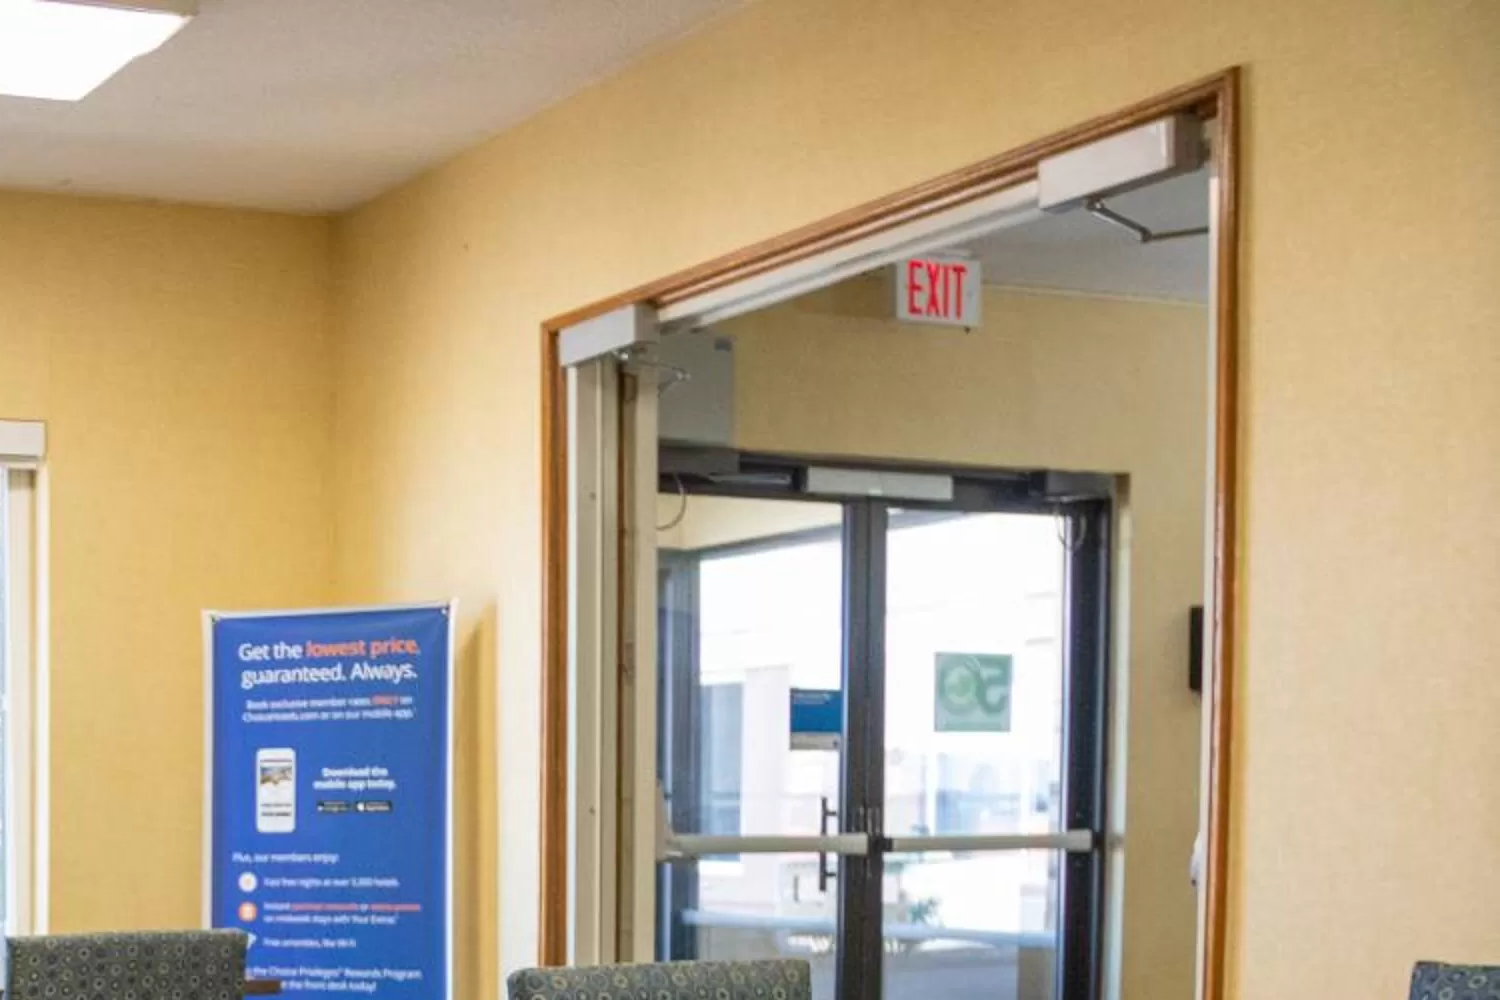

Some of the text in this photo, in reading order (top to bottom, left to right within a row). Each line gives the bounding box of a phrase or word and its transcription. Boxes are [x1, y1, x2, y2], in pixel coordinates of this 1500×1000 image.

[907, 259, 967, 320] EXIT
[238, 642, 271, 661] Get
[273, 640, 303, 660] the
[305, 639, 366, 658] lowest
[241, 661, 418, 690] guaranteed. Always.
[321, 765, 389, 778] Download the
[312, 779, 346, 791] mobile
[347, 780, 366, 793] app
[270, 852, 312, 864] members
